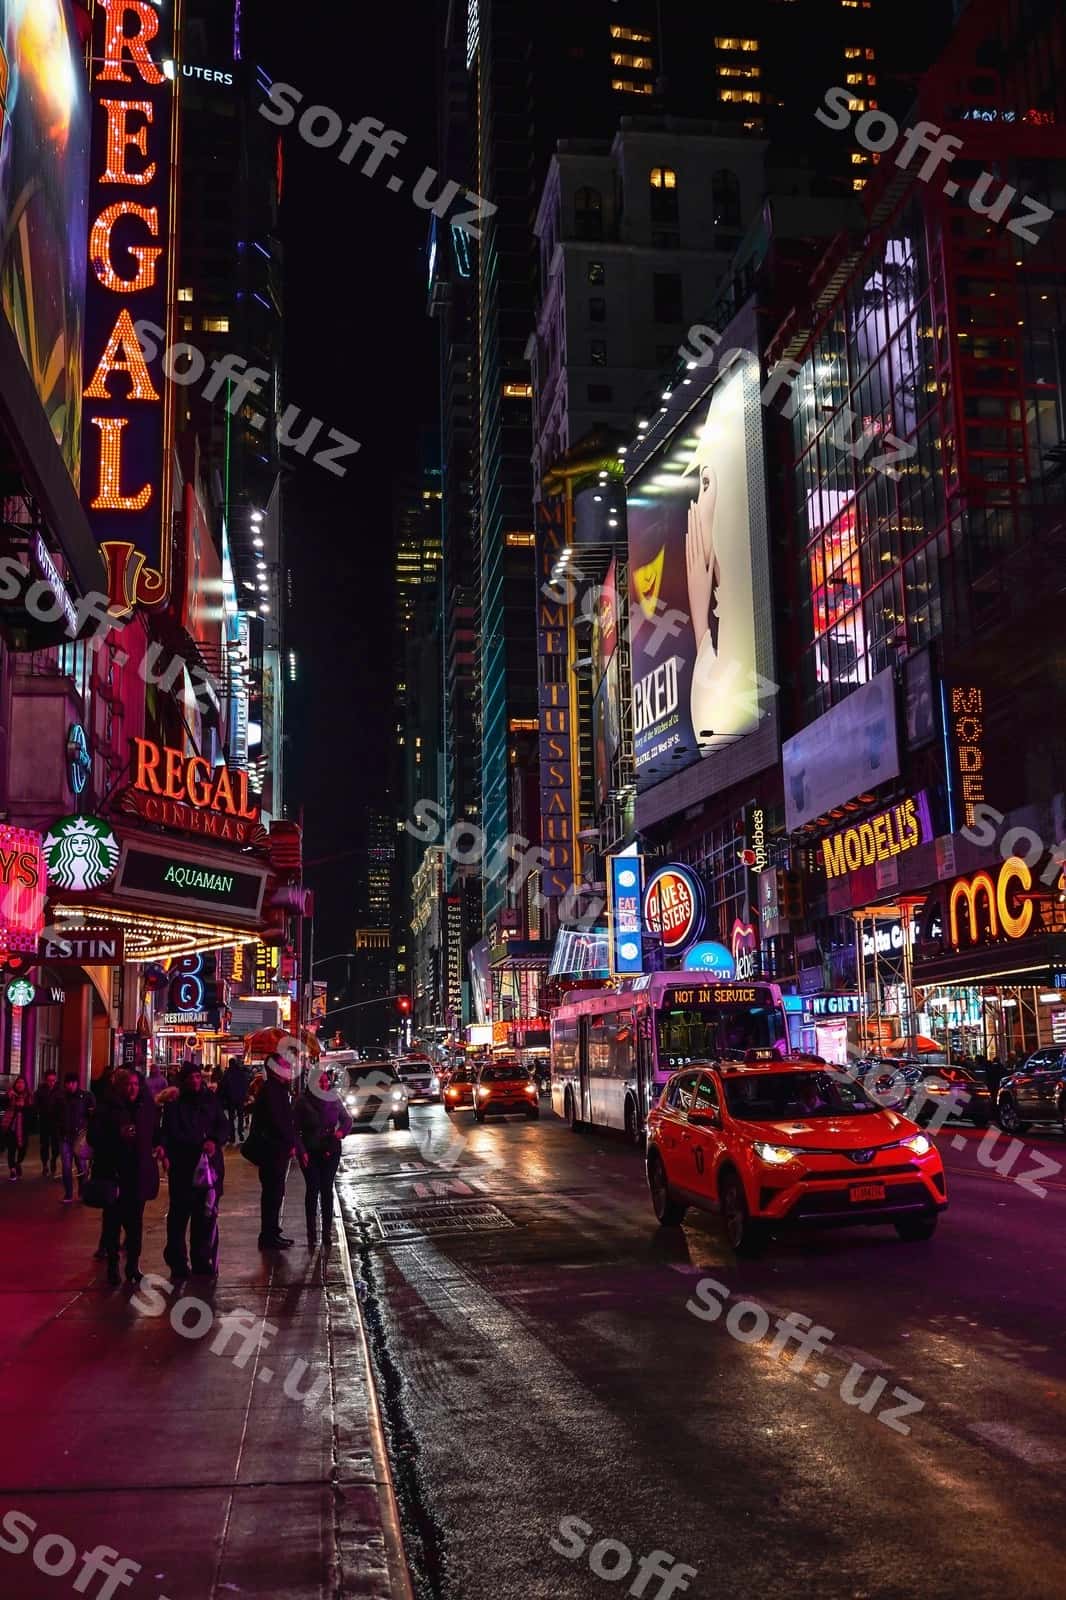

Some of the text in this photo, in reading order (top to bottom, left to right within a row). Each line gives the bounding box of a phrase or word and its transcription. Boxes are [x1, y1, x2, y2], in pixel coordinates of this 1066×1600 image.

[83, 0, 166, 510] REGAL
[134, 736, 257, 820] REGAL
[544, 684, 567, 894] TUSSAUDS
[145, 799, 246, 841] CINEMAS
[751, 809, 767, 873] Applebee's
[822, 799, 918, 878] MODELL'S
[164, 865, 233, 893] AQUAMAN
[677, 882, 688, 901] &
[675, 989, 756, 1003] NOT IN SERVICE
[813, 998, 826, 1014] NY
[164, 1011, 209, 1024] RESTAURANT
